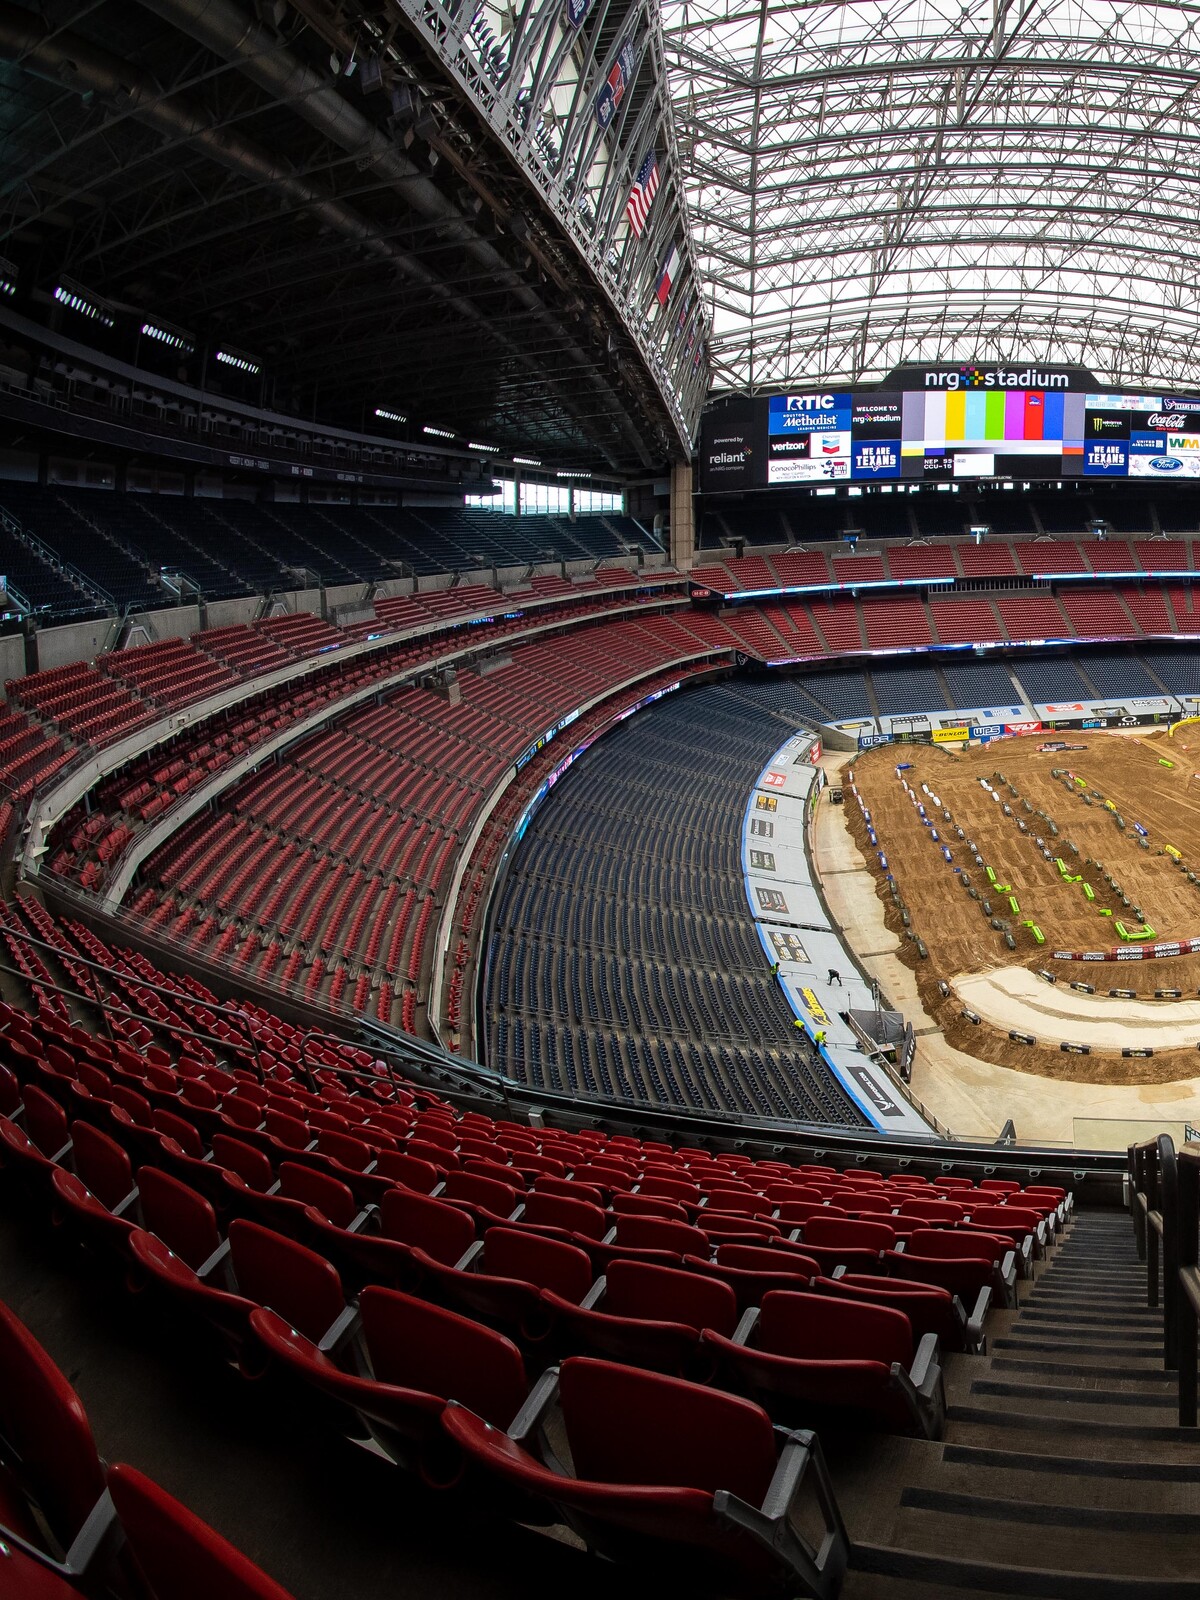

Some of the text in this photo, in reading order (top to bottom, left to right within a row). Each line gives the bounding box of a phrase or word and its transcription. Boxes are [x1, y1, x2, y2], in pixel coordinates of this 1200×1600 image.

[926, 370, 1069, 390] nrg stadium
[787, 395, 834, 411] RTIC
[783, 414, 837, 426] Methodist
[1148, 413, 1187, 427] Coca-Cola
[772, 442, 804, 451] verizon
[1170, 438, 1199, 448] WM
[709, 452, 745, 464] reliant
[856, 456, 896, 466] TEXANS
[1088, 454, 1125, 463] TEXANS
[771, 464, 816, 473] ConocoPhillips
[1157, 460, 1175, 469] Ford
[974, 726, 1000, 736] WPS
